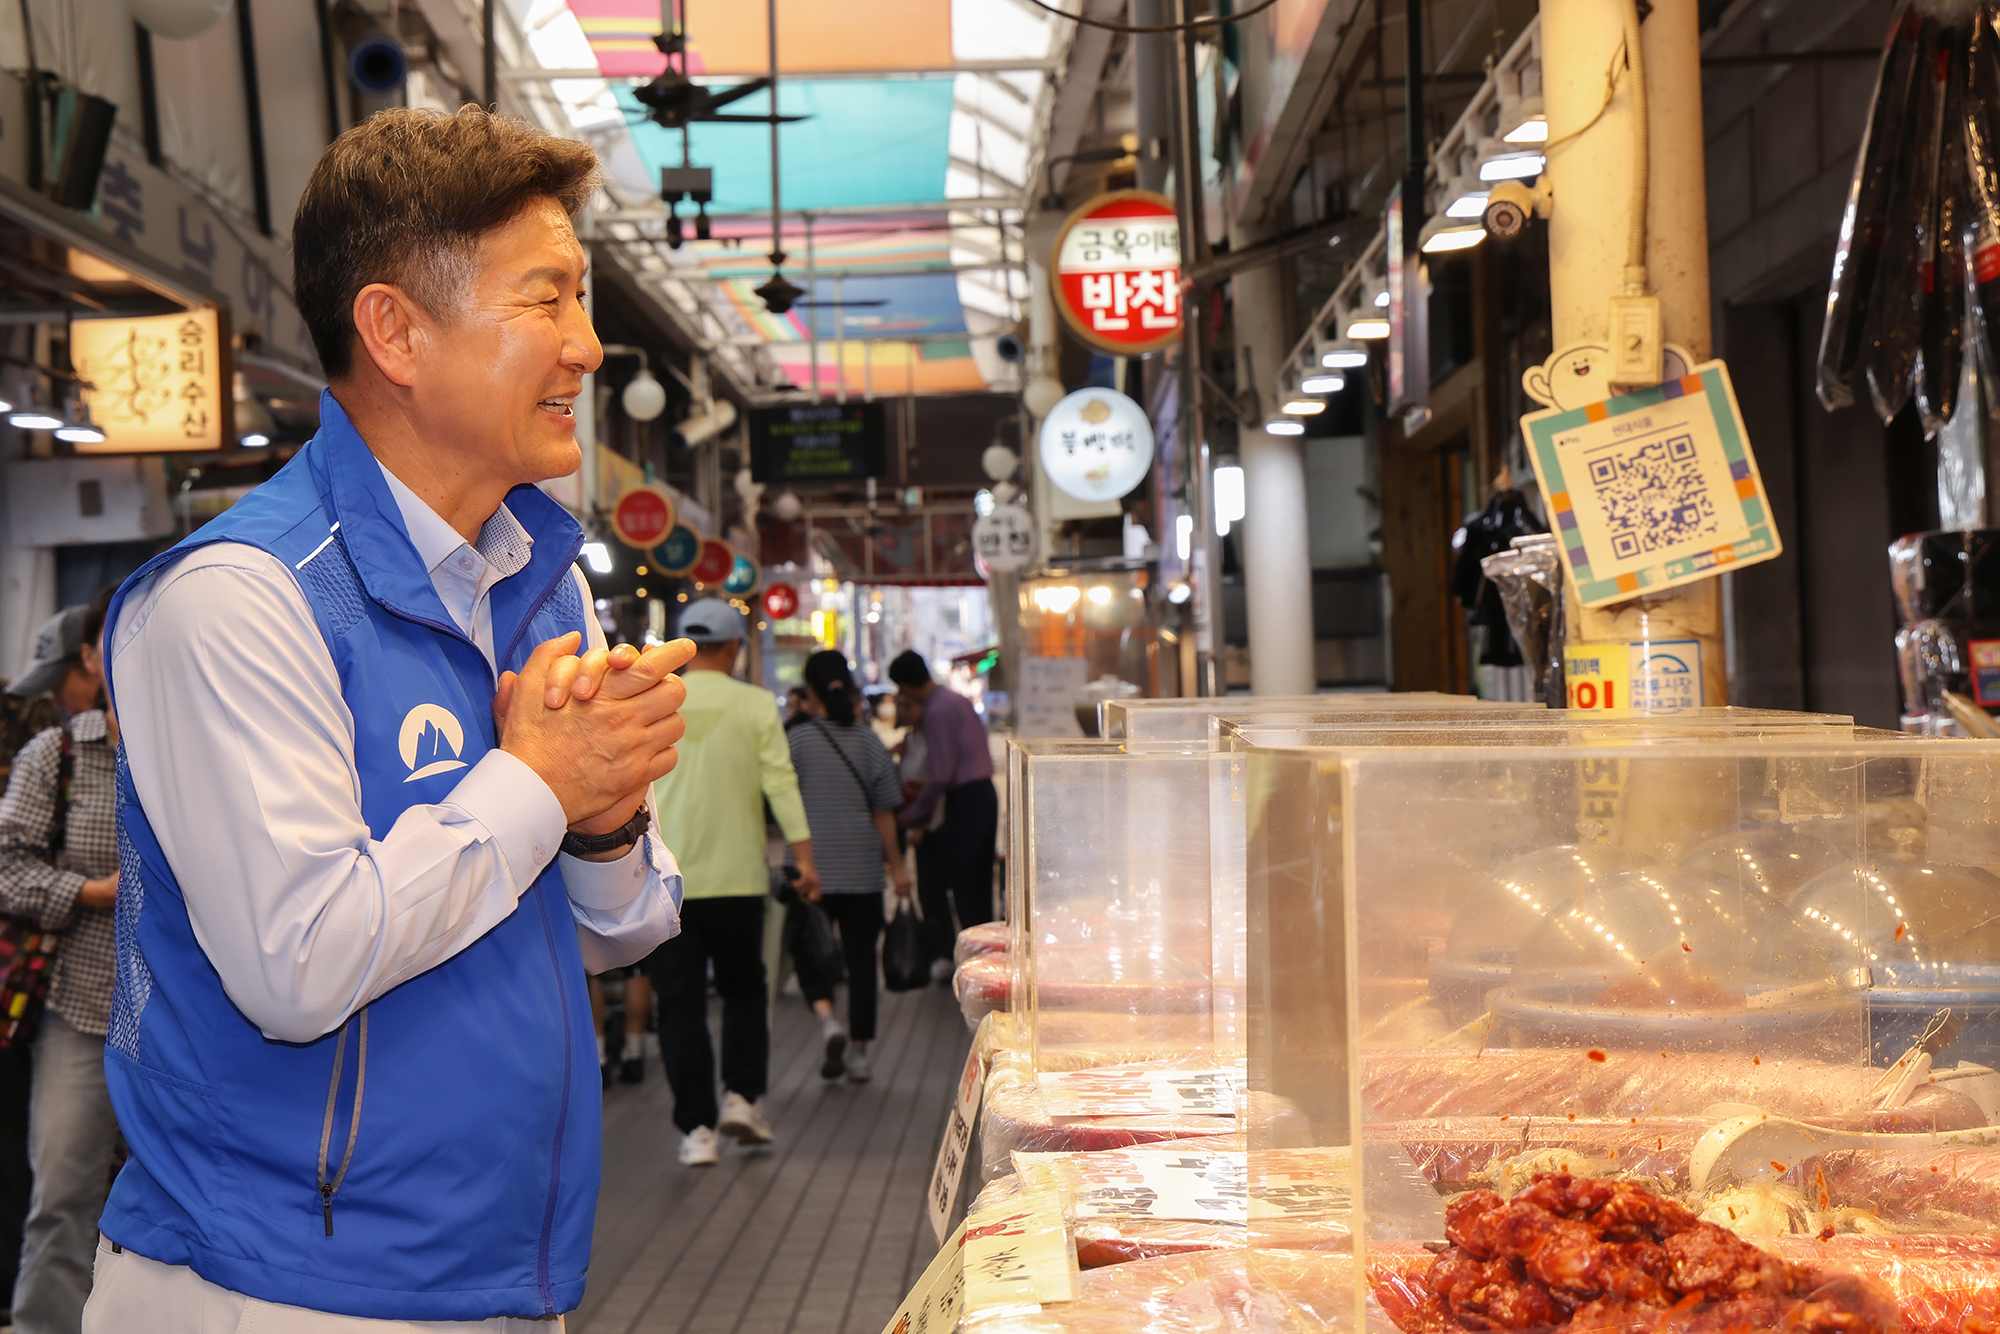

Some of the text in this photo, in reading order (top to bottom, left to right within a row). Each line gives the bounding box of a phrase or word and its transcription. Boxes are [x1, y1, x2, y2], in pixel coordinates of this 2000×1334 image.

[1081, 270, 1180, 331] 반찬
[177, 317, 209, 440] 승리수산
[1631, 676, 1693, 696] 전통시장
